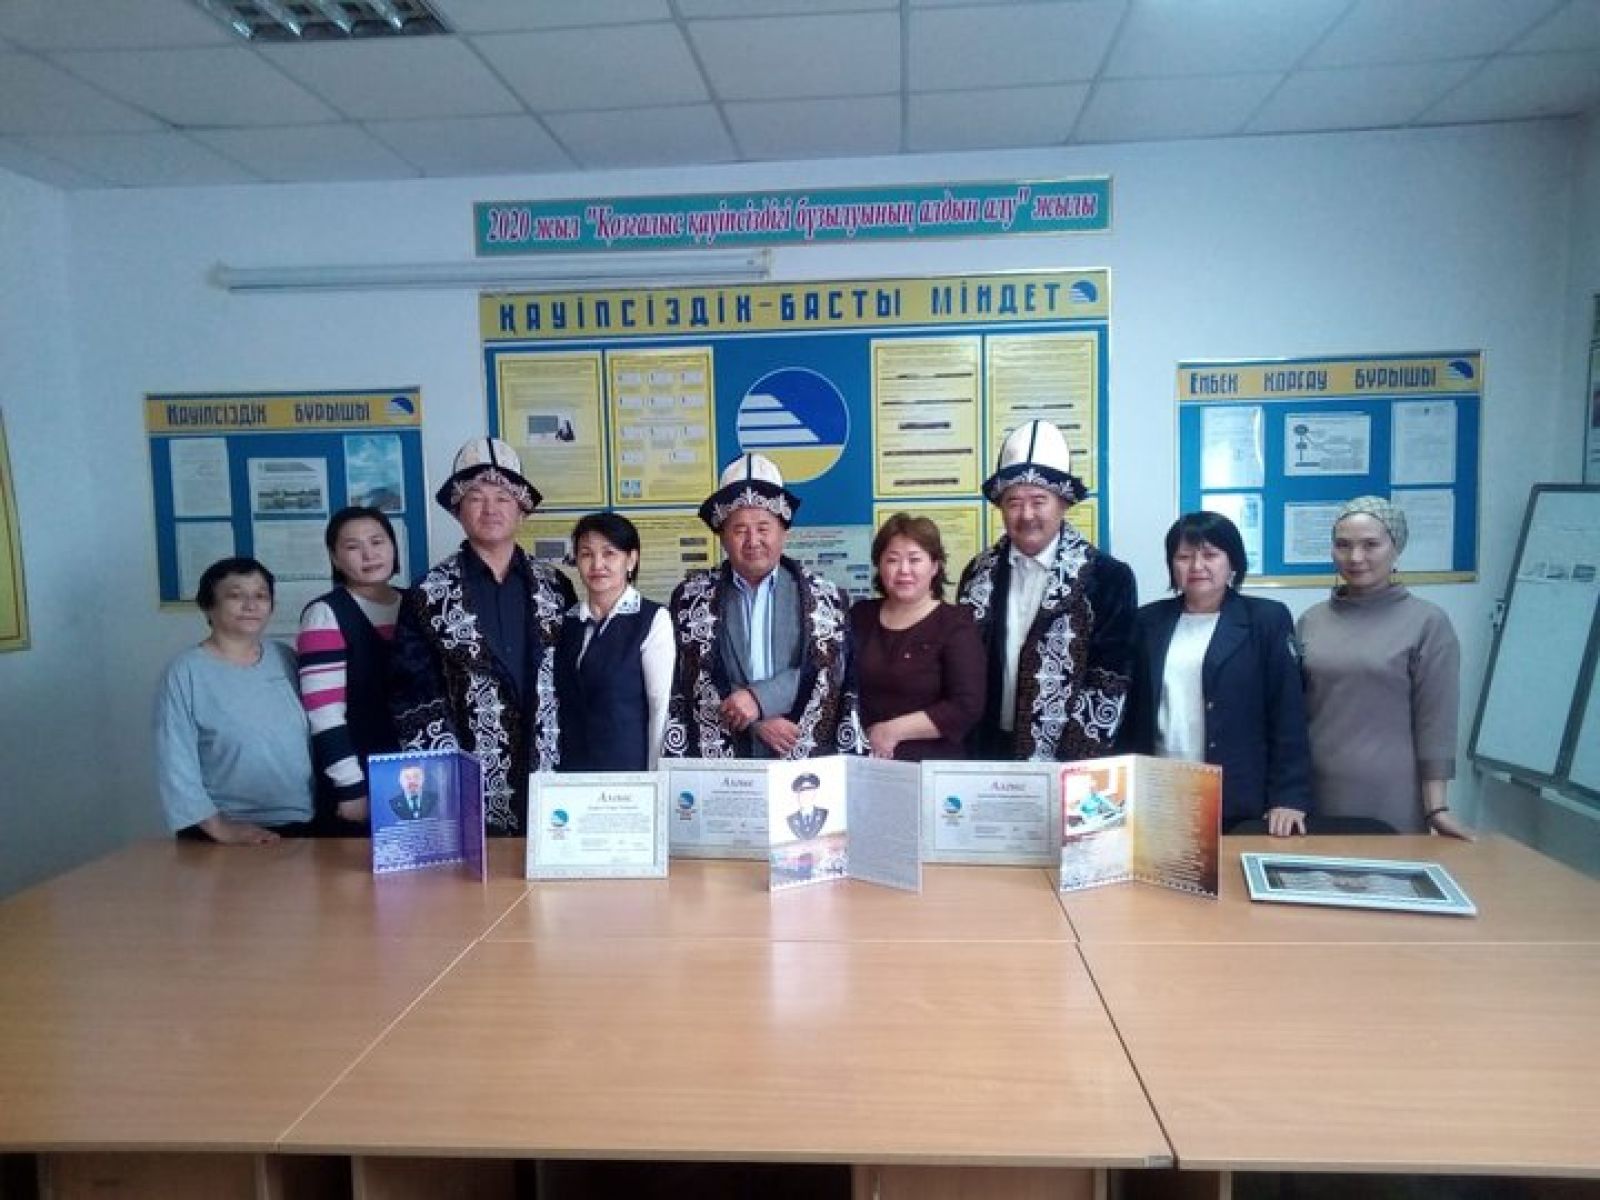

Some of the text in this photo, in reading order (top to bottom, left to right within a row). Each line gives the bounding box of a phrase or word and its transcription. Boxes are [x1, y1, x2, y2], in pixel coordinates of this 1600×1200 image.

[487, 208, 532, 242] 2020
[534, 217, 581, 241] жыл
[919, 187, 981, 227] алдын
[1032, 193, 1099, 221] жылы
[931, 280, 1061, 315] МІНДЕТ
